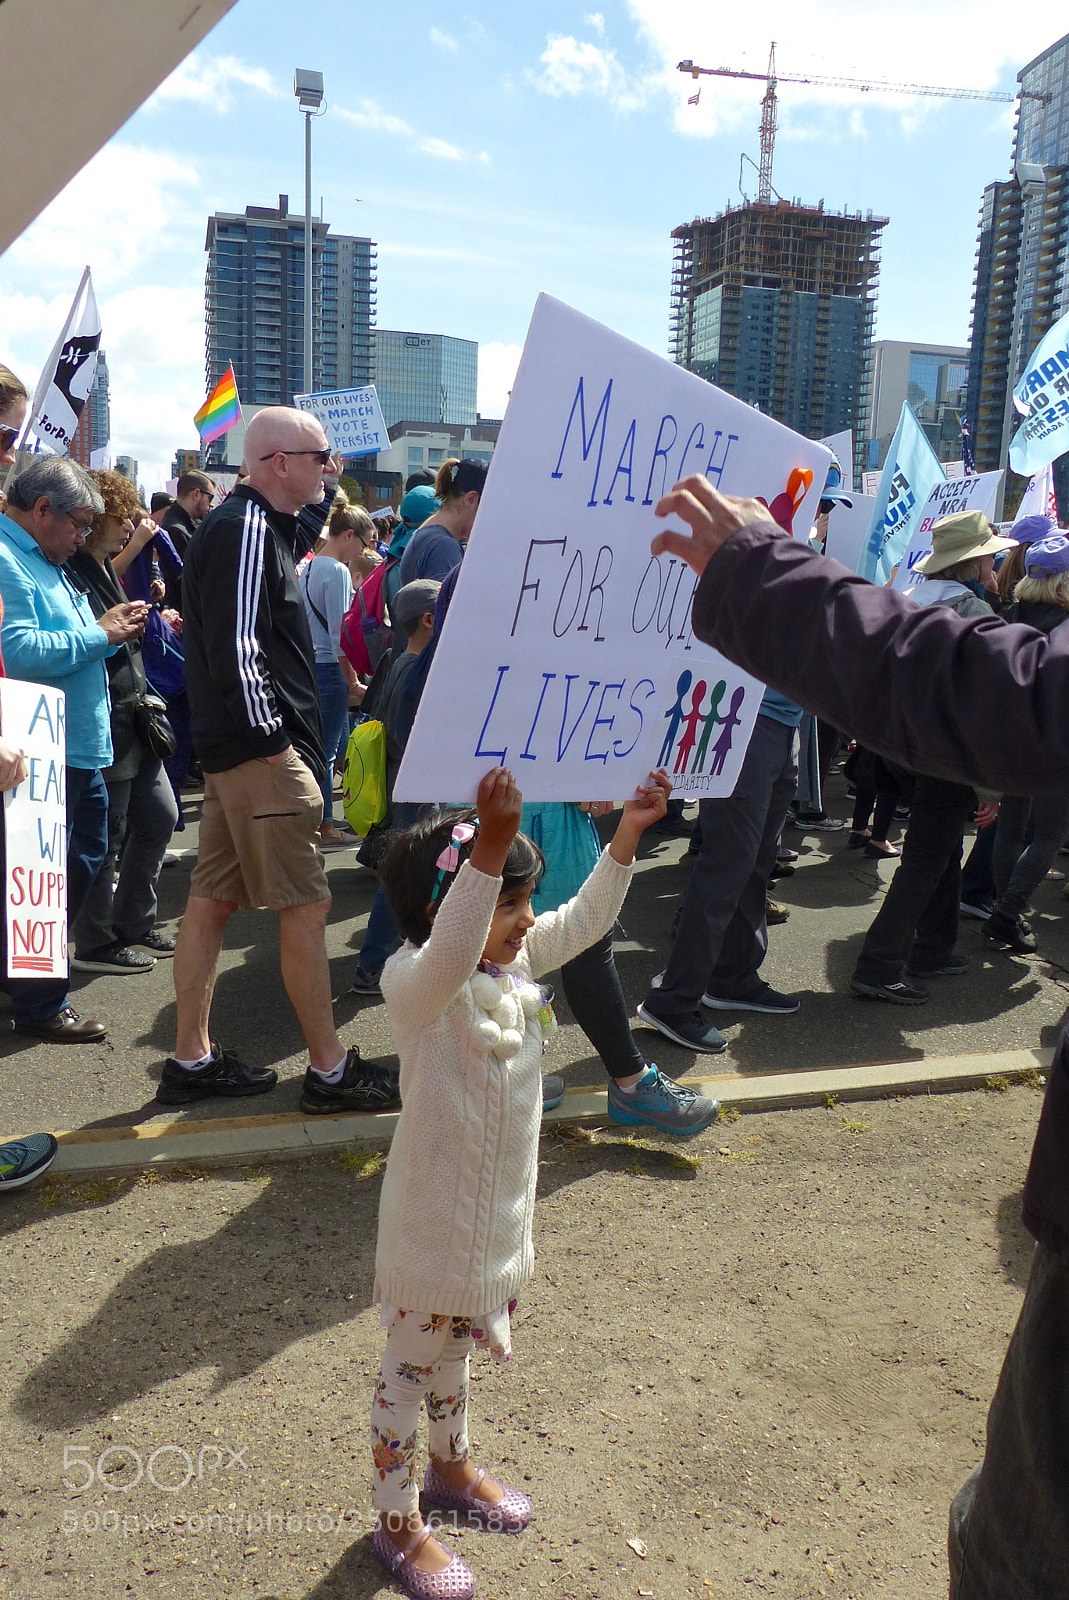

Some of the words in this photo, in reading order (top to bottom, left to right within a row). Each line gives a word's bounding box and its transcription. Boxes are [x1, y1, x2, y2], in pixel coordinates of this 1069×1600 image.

[300, 399, 319, 410] FOR
[322, 396, 341, 406] OUR
[328, 406, 374, 419] MARCH
[332, 419, 369, 432] VOTE
[551, 377, 738, 507] MARCH
[928, 479, 980, 502] ACCEPT
[939, 498, 968, 514] NRA
[511, 536, 613, 641] FOR
[475, 666, 655, 766] LIVES
[667, 774, 713, 791] IDARITY
[10, 866, 66, 911] SUPP
[12, 919, 56, 958] NOT
